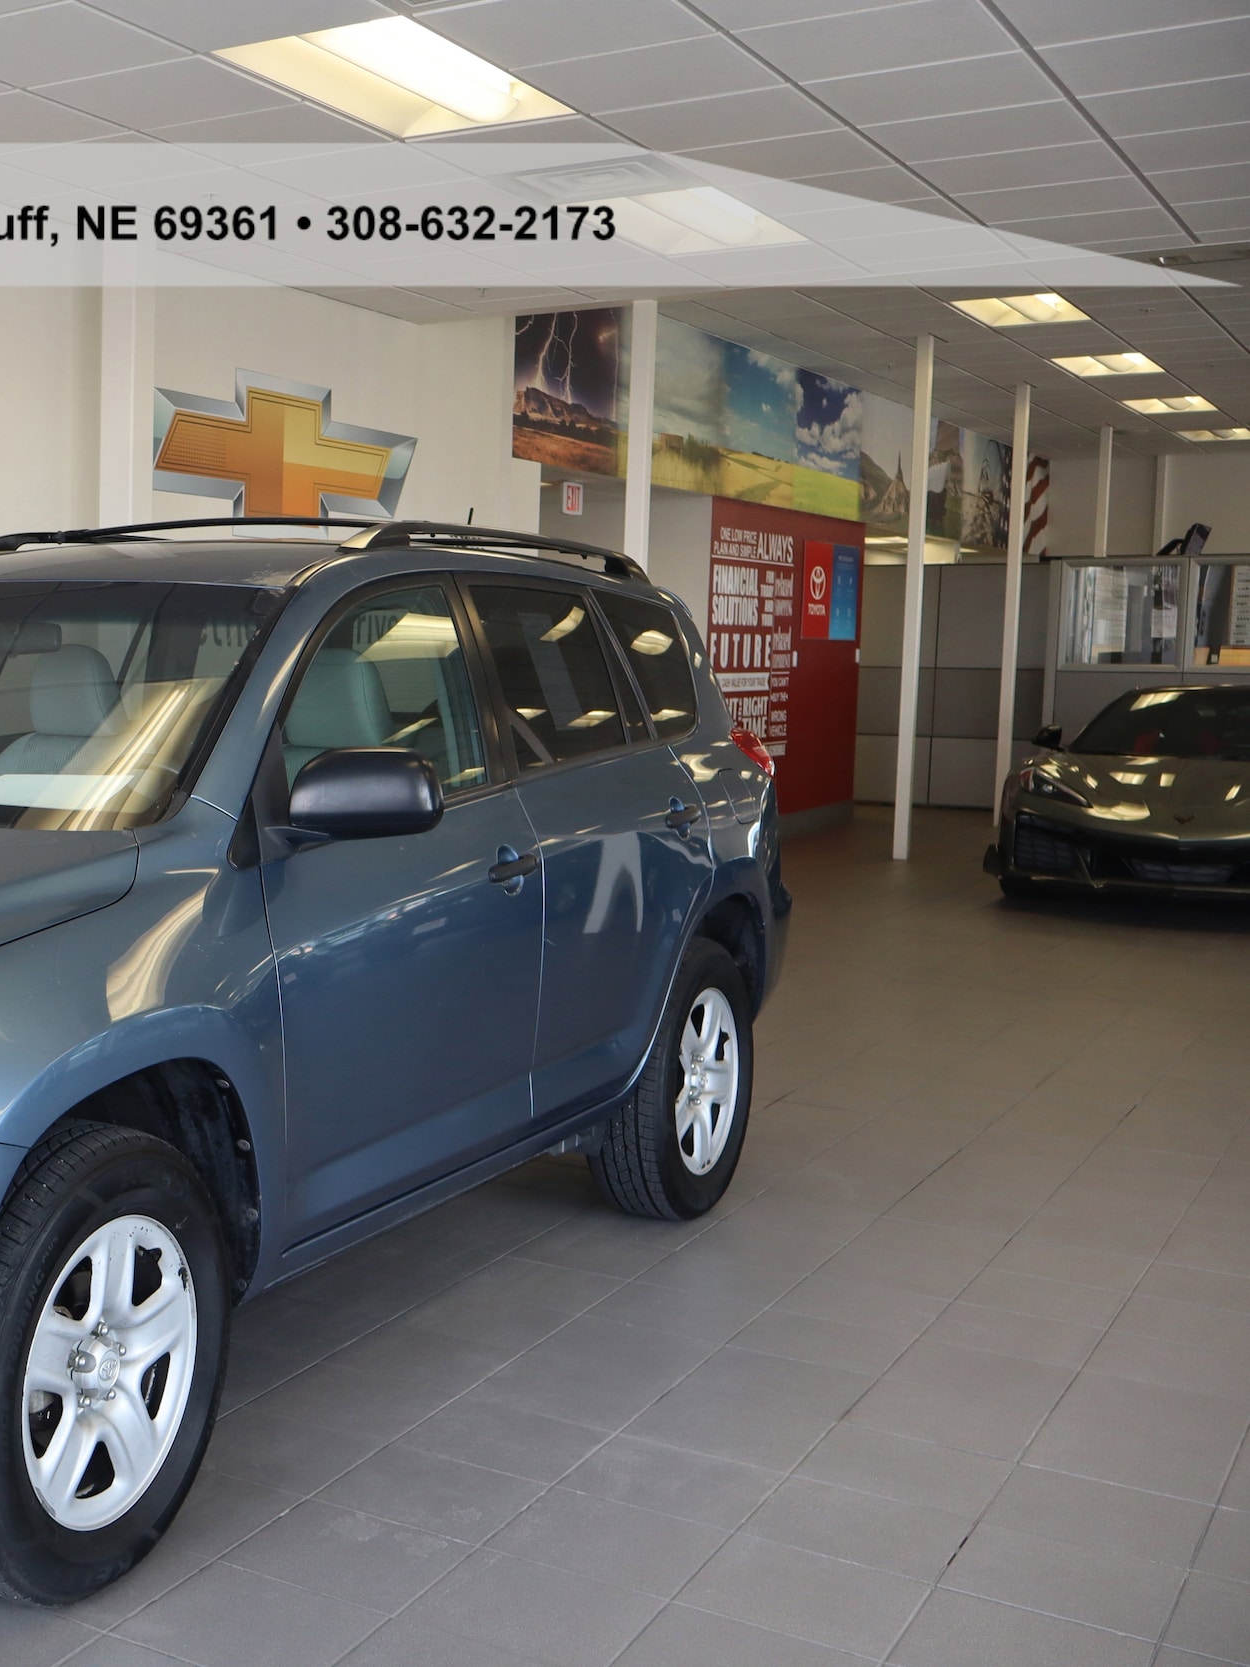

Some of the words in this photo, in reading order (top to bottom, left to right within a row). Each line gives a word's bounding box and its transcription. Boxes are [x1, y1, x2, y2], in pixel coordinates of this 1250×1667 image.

[566, 484, 581, 512] EXIT
[757, 532, 794, 563] ALWAYS
[713, 564, 759, 597] FINANCIAL
[712, 594, 759, 627] SOLUTIONS
[710, 632, 771, 669] FUTURE
[743, 696, 769, 717] RIGHT
[742, 716, 767, 738] TIME
